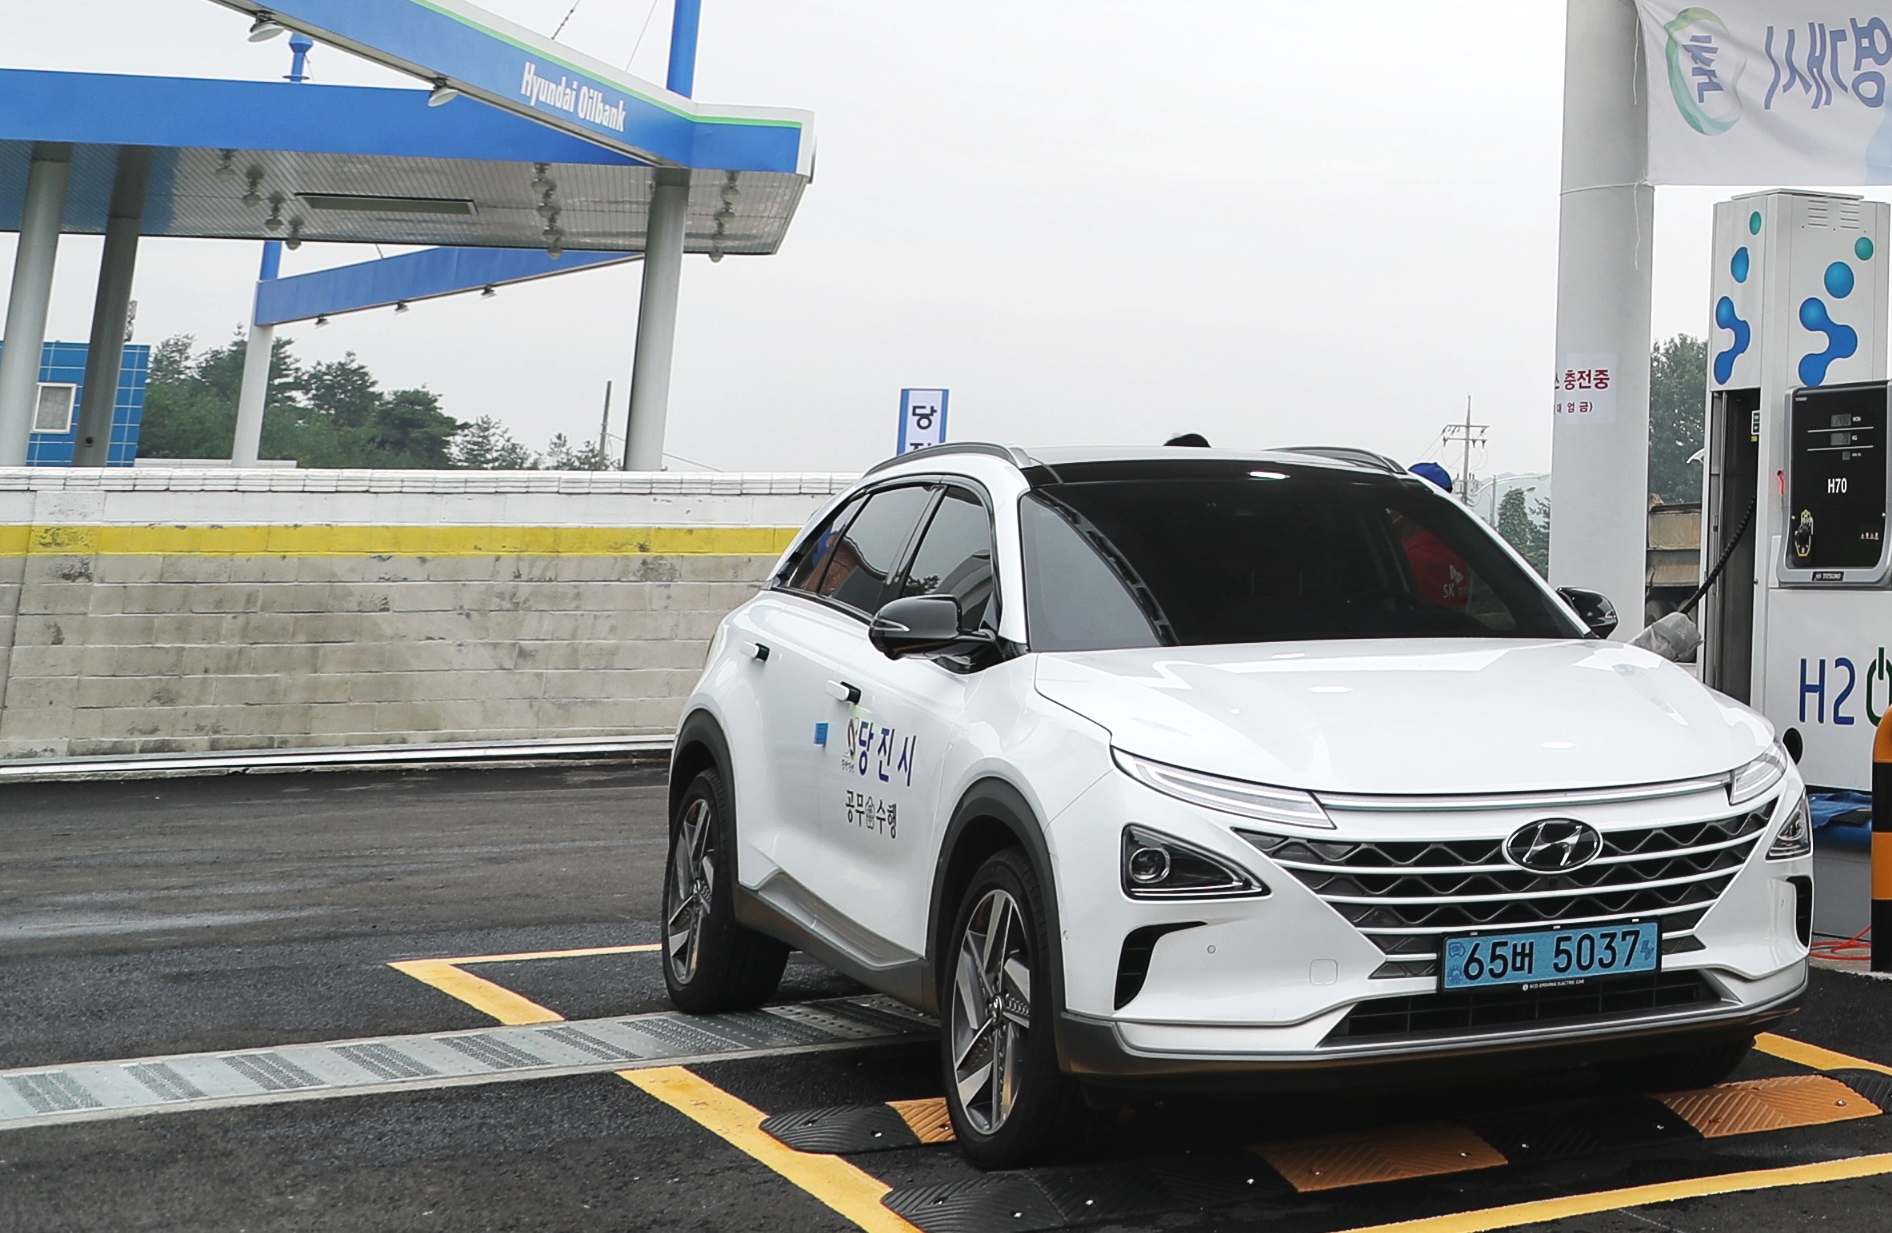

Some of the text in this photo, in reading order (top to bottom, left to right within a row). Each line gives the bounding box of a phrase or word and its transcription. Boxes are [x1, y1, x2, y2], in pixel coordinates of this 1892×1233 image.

[521, 61, 626, 132] Hyundai Oilbank
[1564, 369, 1610, 391] 충전중
[1827, 477, 1848, 494] H70
[858, 720, 917, 787] 당진시
[1463, 930, 1641, 981] 65버 5037
